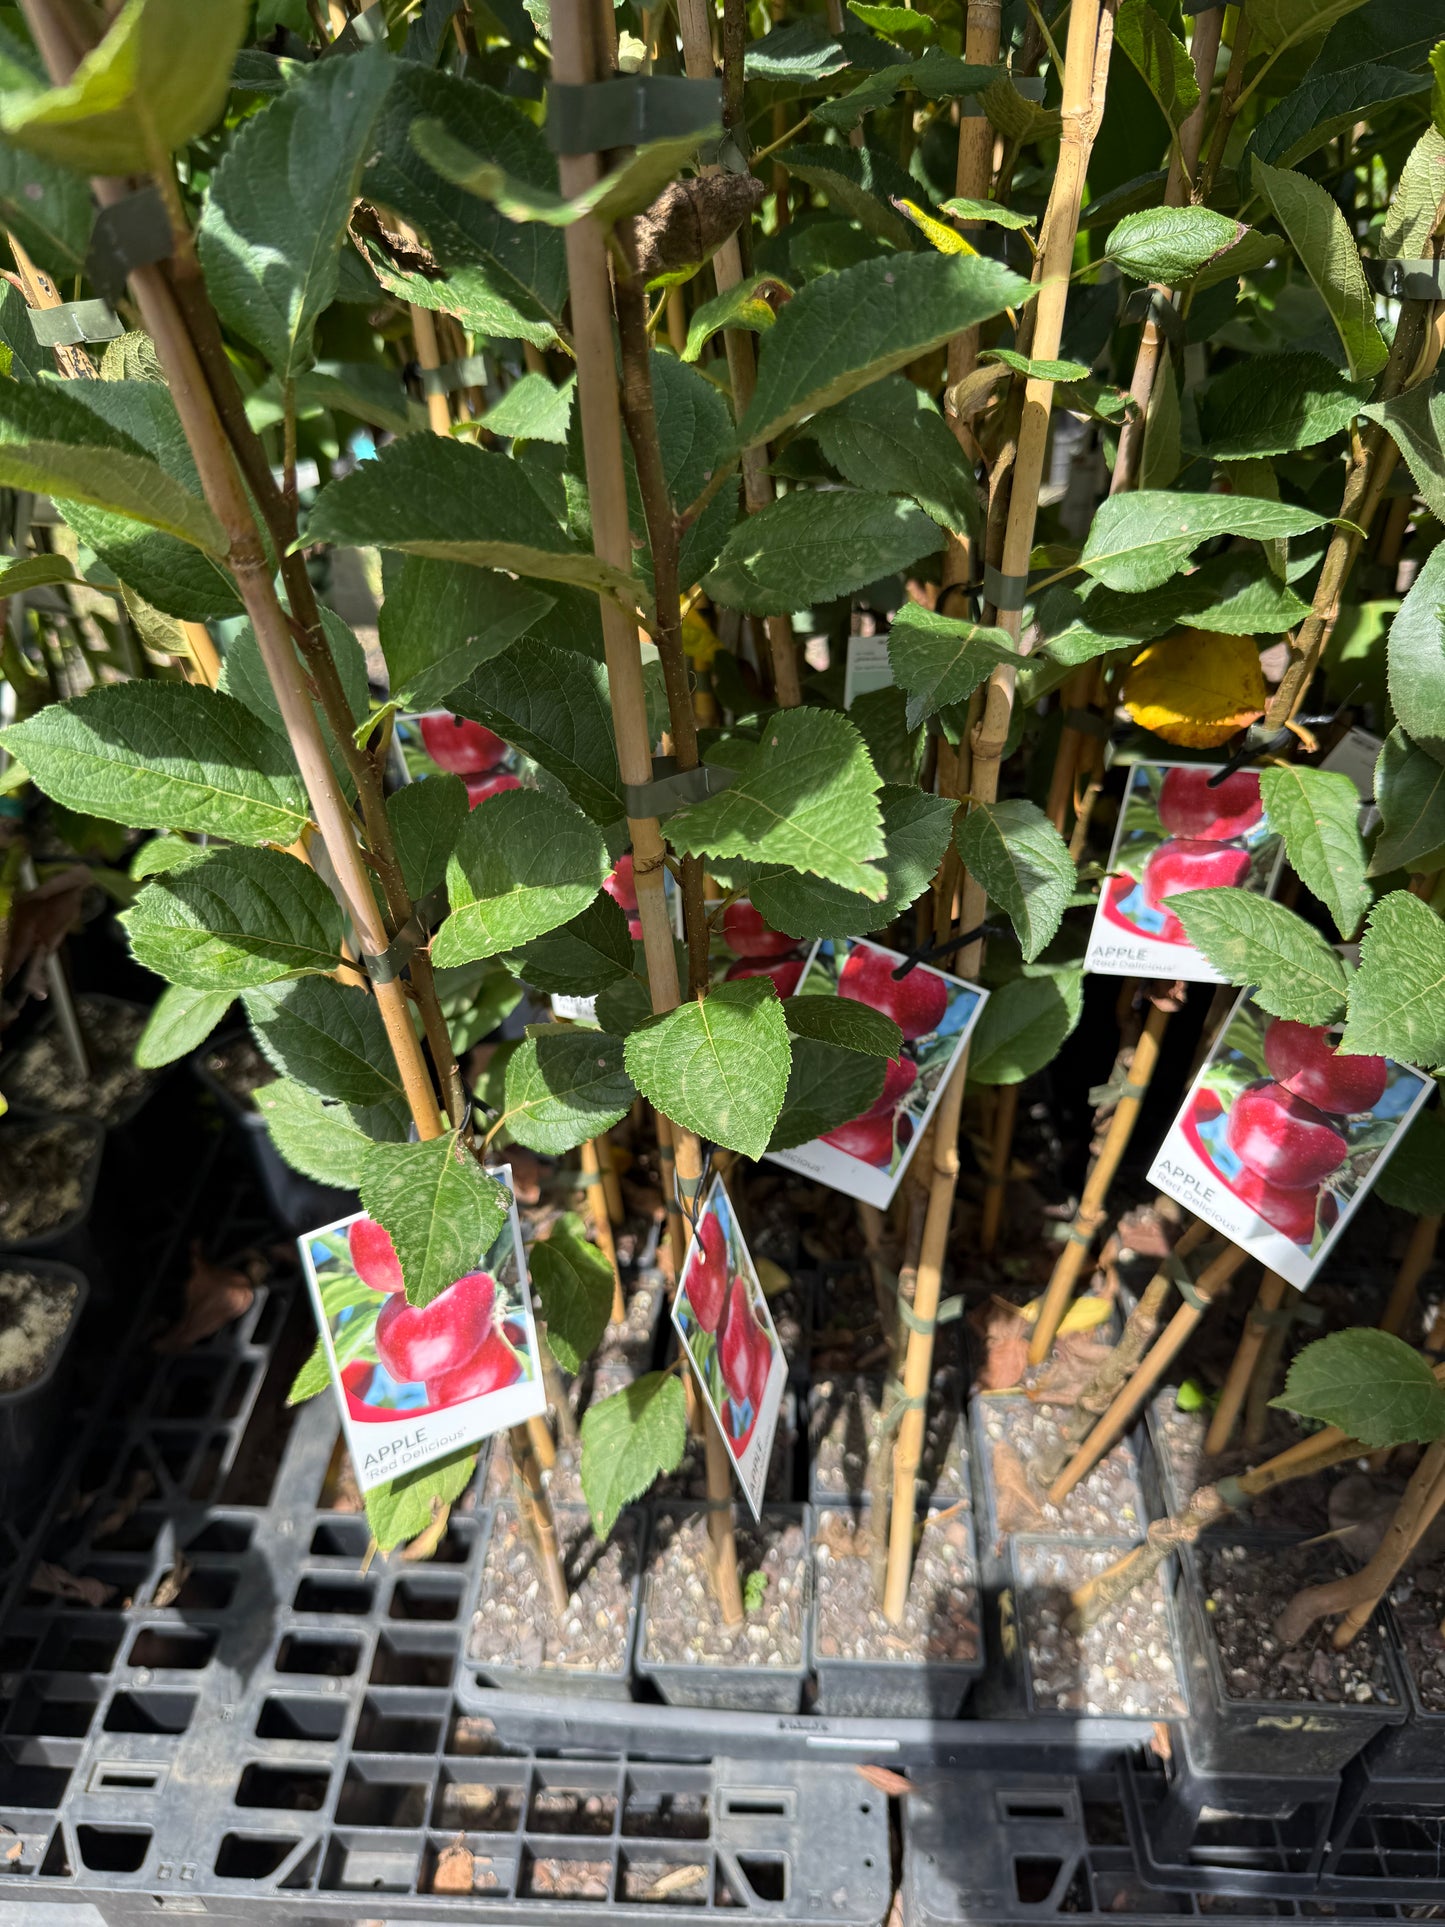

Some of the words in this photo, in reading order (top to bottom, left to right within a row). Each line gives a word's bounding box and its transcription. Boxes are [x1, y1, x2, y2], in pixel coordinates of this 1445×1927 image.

[1092, 946, 1147, 960] APPLE
[1159, 1160, 1215, 1202] APPLE
[364, 1427, 428, 1470] APPLE
[366, 1461, 398, 1480] 'Red
[402, 1426, 467, 1464] Delicious'
